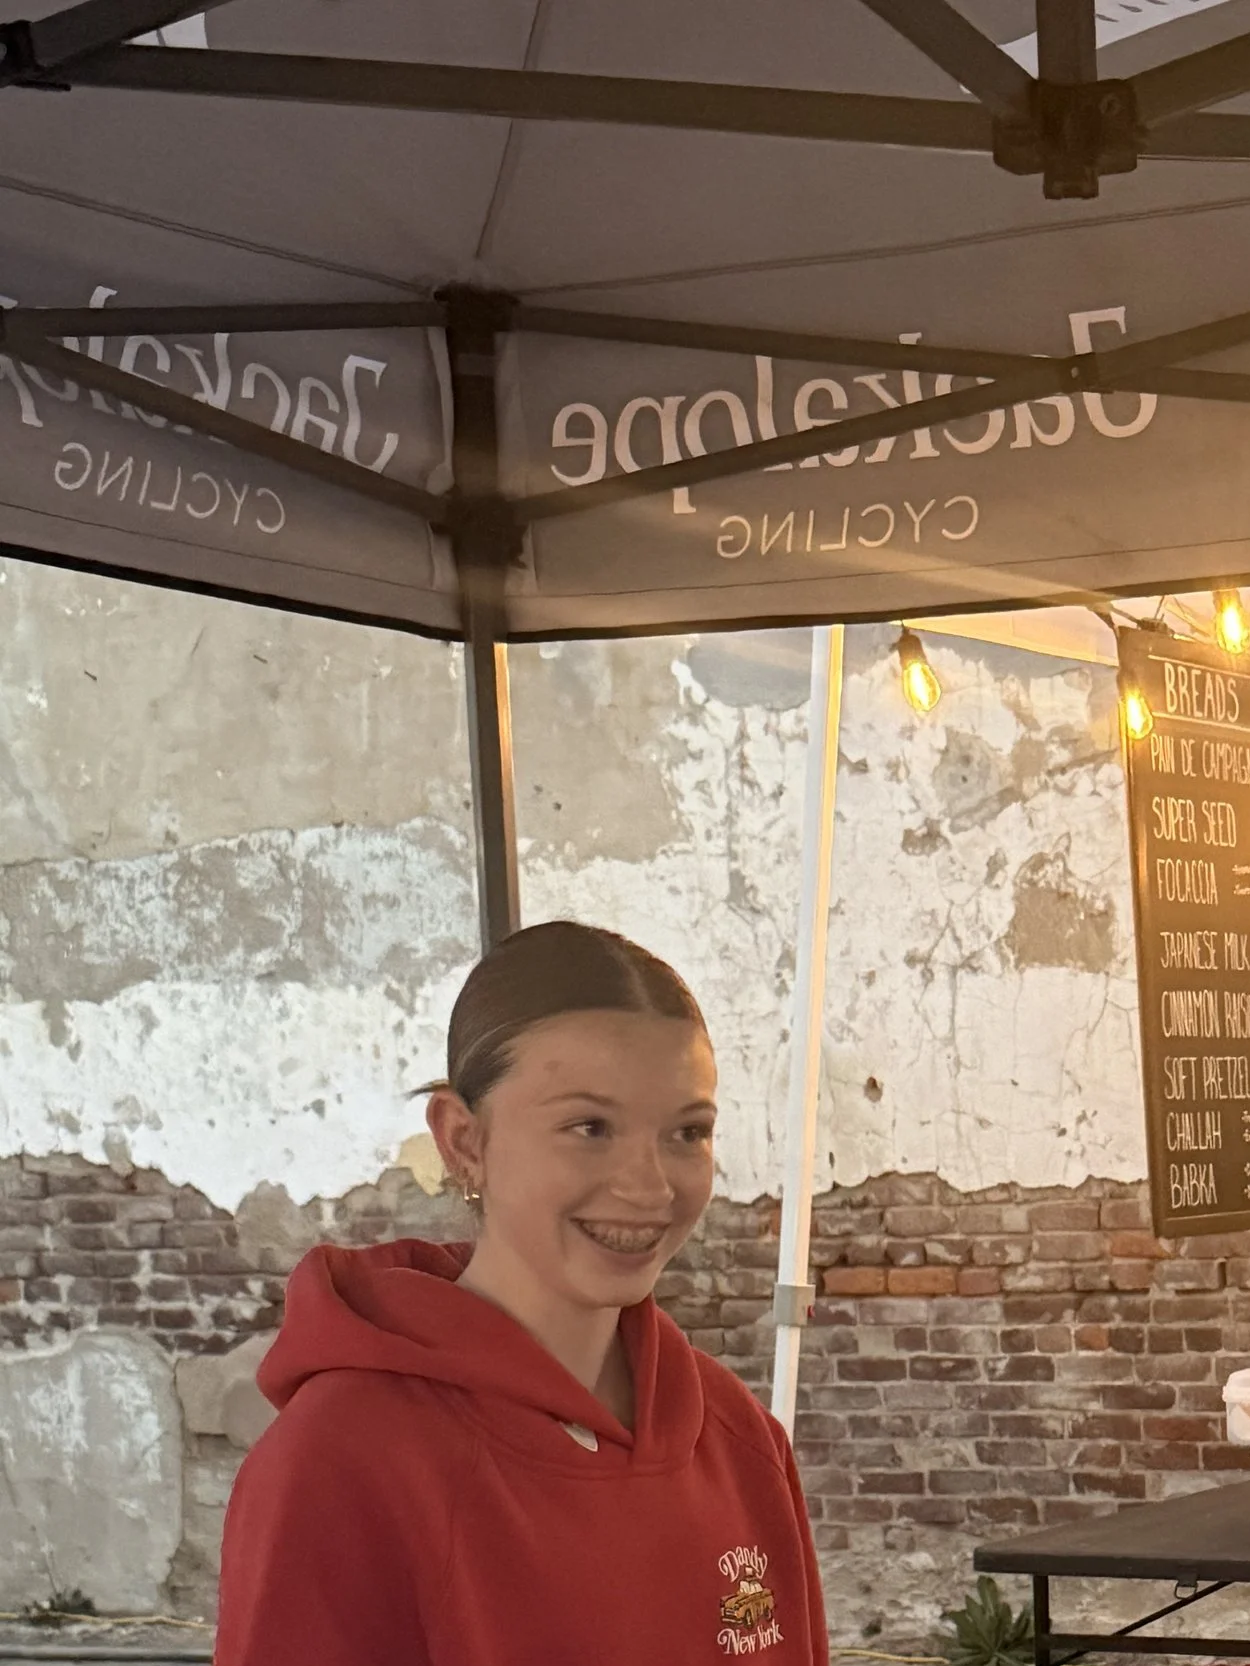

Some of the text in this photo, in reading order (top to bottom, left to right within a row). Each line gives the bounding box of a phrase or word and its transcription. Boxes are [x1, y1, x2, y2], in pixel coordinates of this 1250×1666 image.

[1165, 662, 1240, 723] BREADS
[1151, 732, 1175, 774] PAIN
[1181, 738, 1197, 778] DE
[1152, 796, 1237, 848] SUPER SEED
[1157, 858, 1218, 906] FOCACCIA
[1160, 931, 1218, 970] JAPANESE
[1224, 932, 1250, 971] MILK
[1161, 989, 1220, 1038] CINNAMON
[1164, 1056, 1197, 1100] SOFT
[1167, 1111, 1222, 1151] CHALLAH
[1171, 1163, 1218, 1209] BABKA
[718, 1545, 768, 1583] Dandy
[717, 1619, 784, 1656] New York
